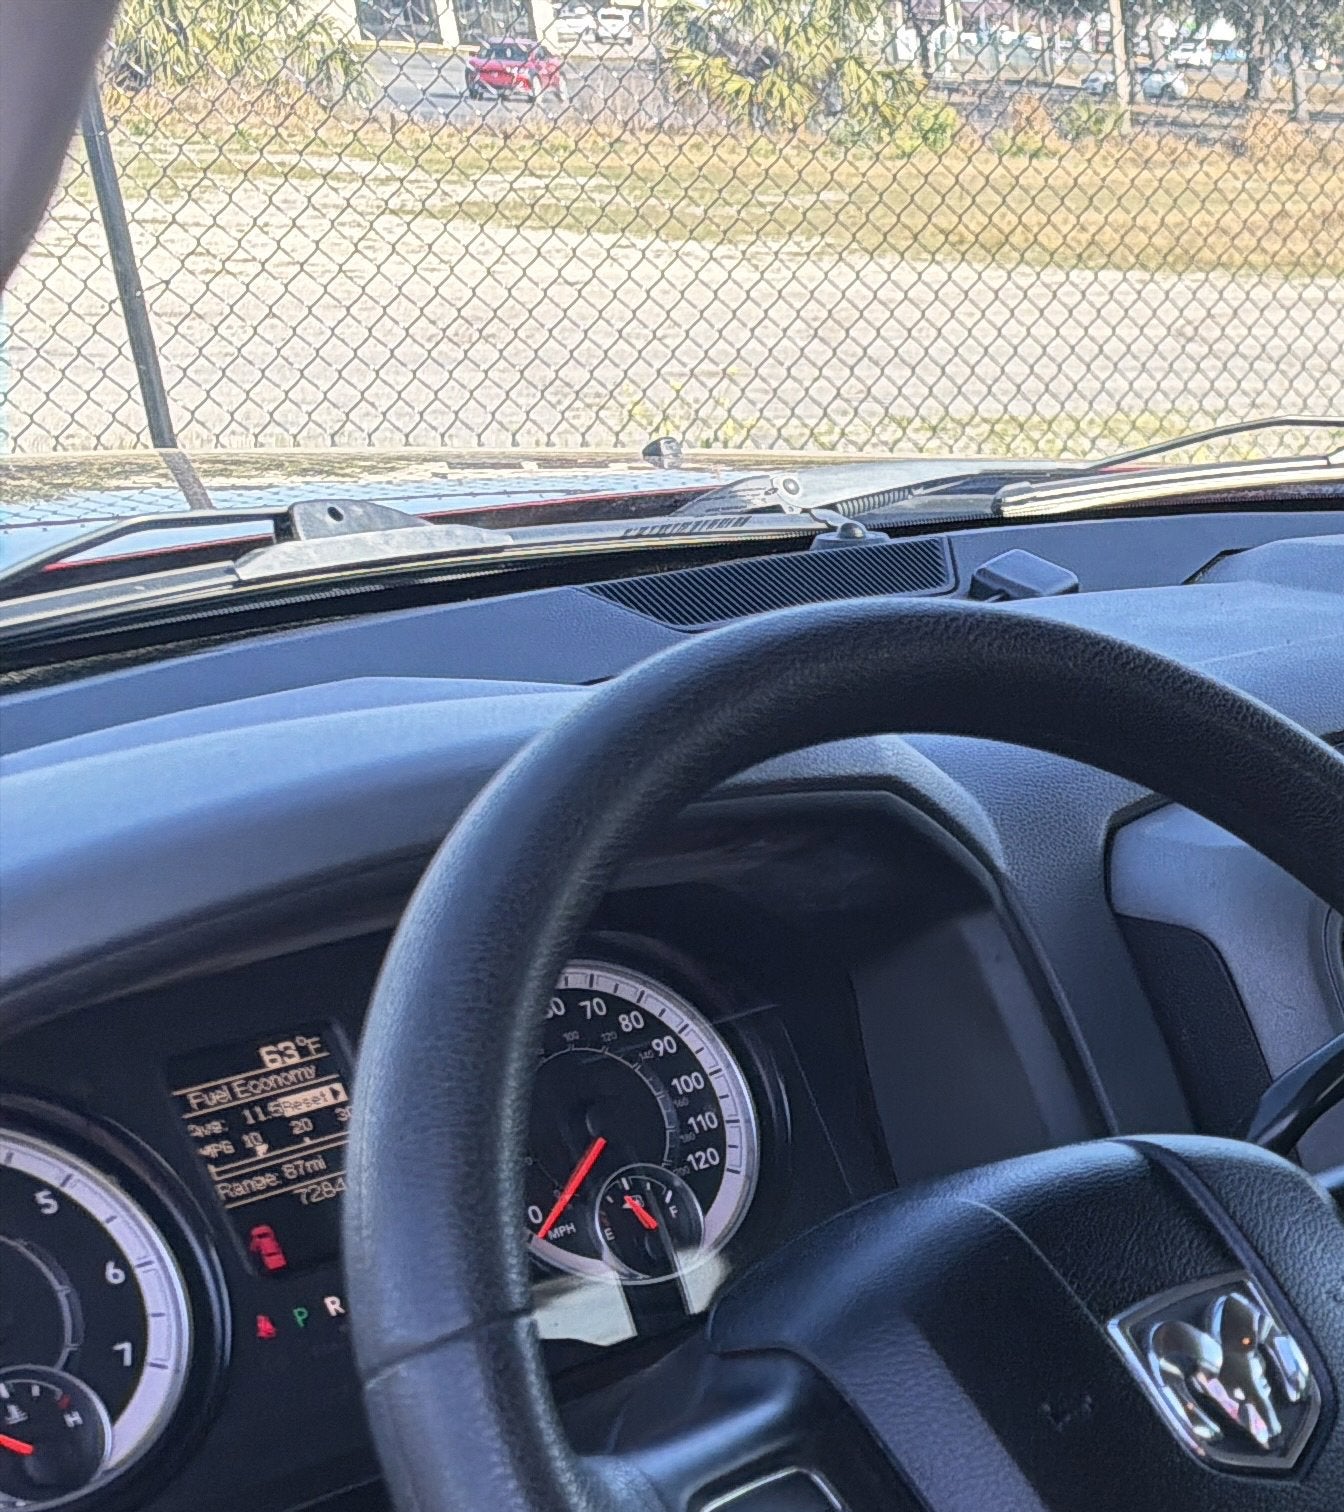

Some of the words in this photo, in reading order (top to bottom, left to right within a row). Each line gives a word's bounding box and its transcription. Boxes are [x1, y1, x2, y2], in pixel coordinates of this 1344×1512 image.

[578, 997, 607, 1020] 70
[618, 1011, 645, 1033] 80
[651, 1035, 677, 1057] 90
[186, 1085, 232, 1110] Fuel
[232, 1064, 317, 1099] Economy
[671, 1071, 705, 1095] 100
[241, 1131, 264, 1149] 10
[289, 1117, 314, 1135] 20
[687, 1111, 718, 1135] 110
[686, 1147, 720, 1172] 120
[34, 1190, 59, 1215] 5
[668, 1206, 679, 1219] F
[527, 1205, 543, 1225] 0
[547, 1222, 577, 1240] MPH
[604, 1228, 615, 1241] E
[105, 1260, 126, 1285] 6
[323, 1295, 346, 1317] R
[293, 1307, 309, 1328] P
[112, 1341, 132, 1367] 7
[63, 1410, 84, 1429] H
